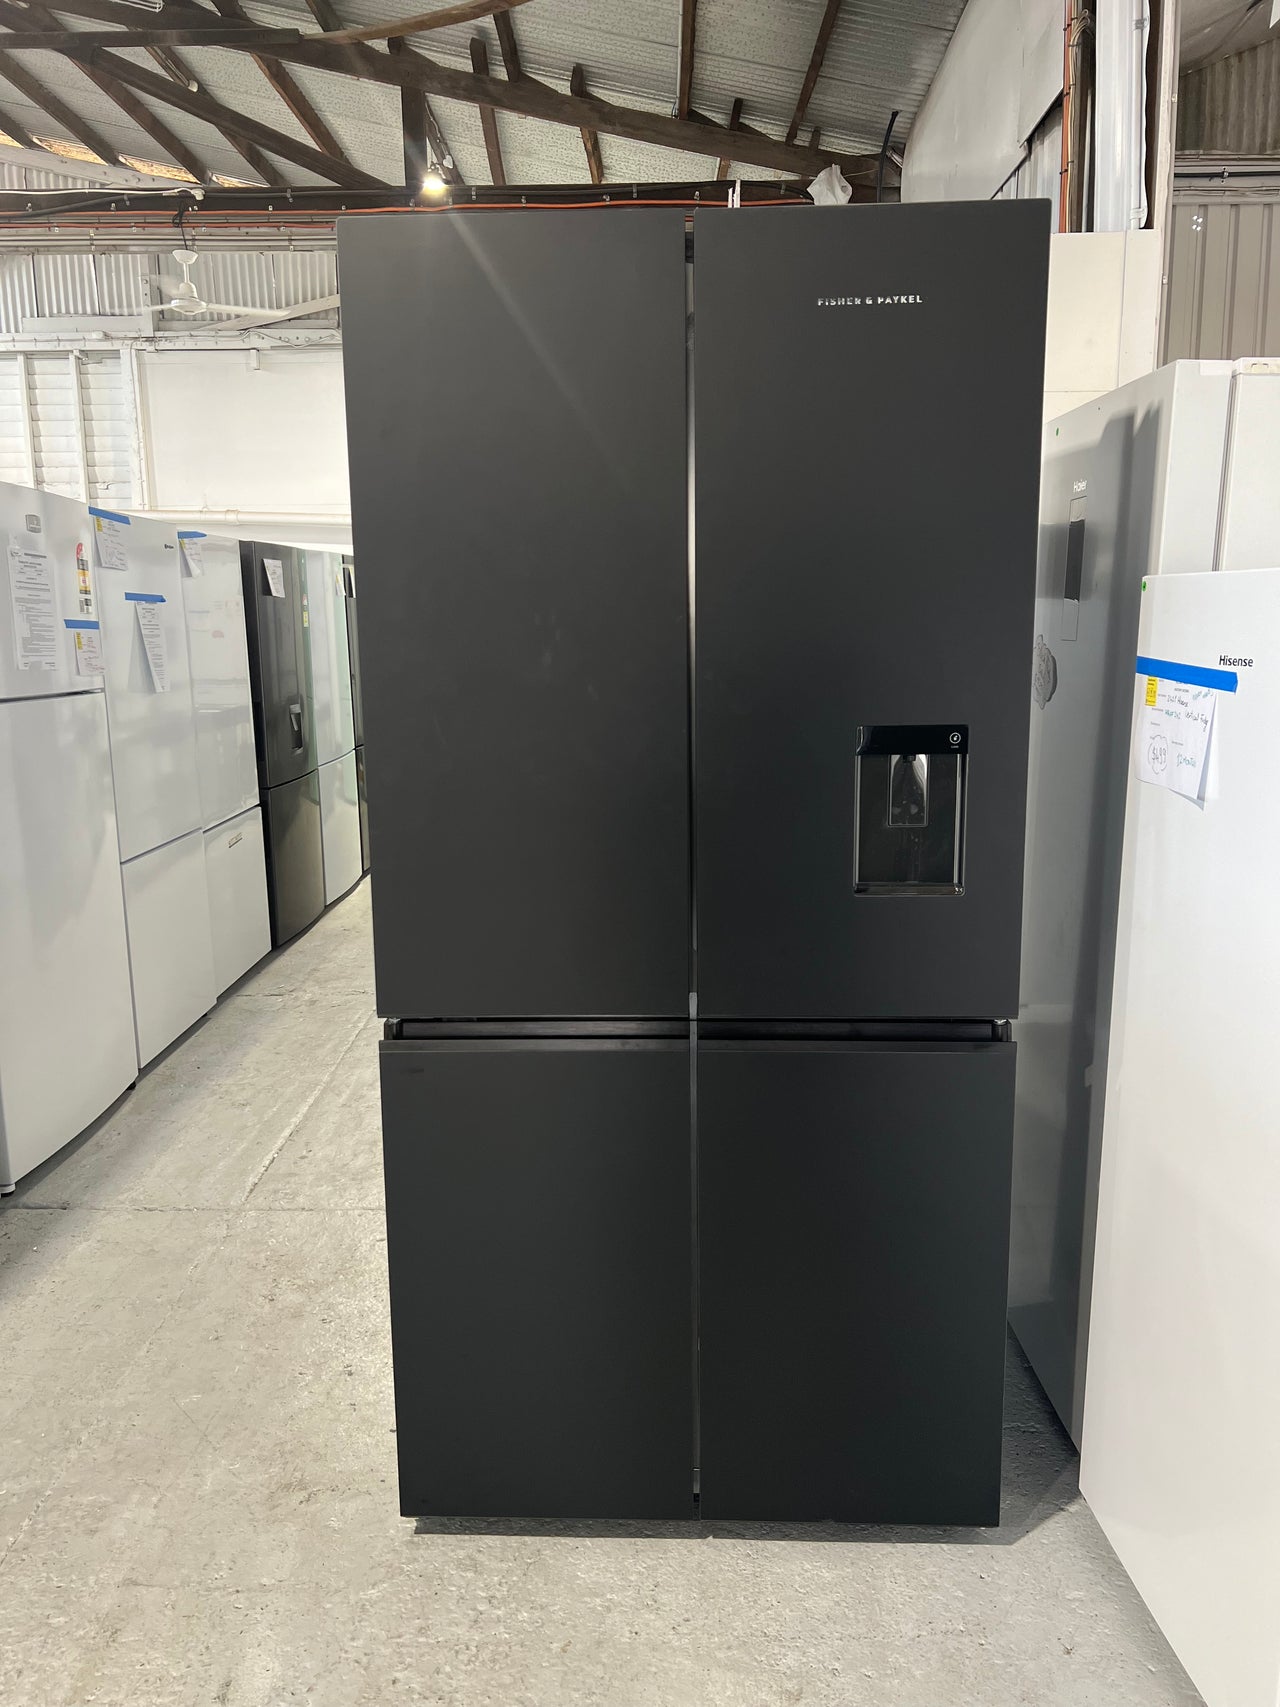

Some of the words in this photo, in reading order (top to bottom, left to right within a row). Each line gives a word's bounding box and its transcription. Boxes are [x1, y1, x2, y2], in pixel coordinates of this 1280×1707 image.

[818, 297, 862, 306] FISHER
[877, 295, 923, 304] PAYKEL
[1073, 479, 1088, 492] Haier
[1218, 654, 1254, 668] Hisense
